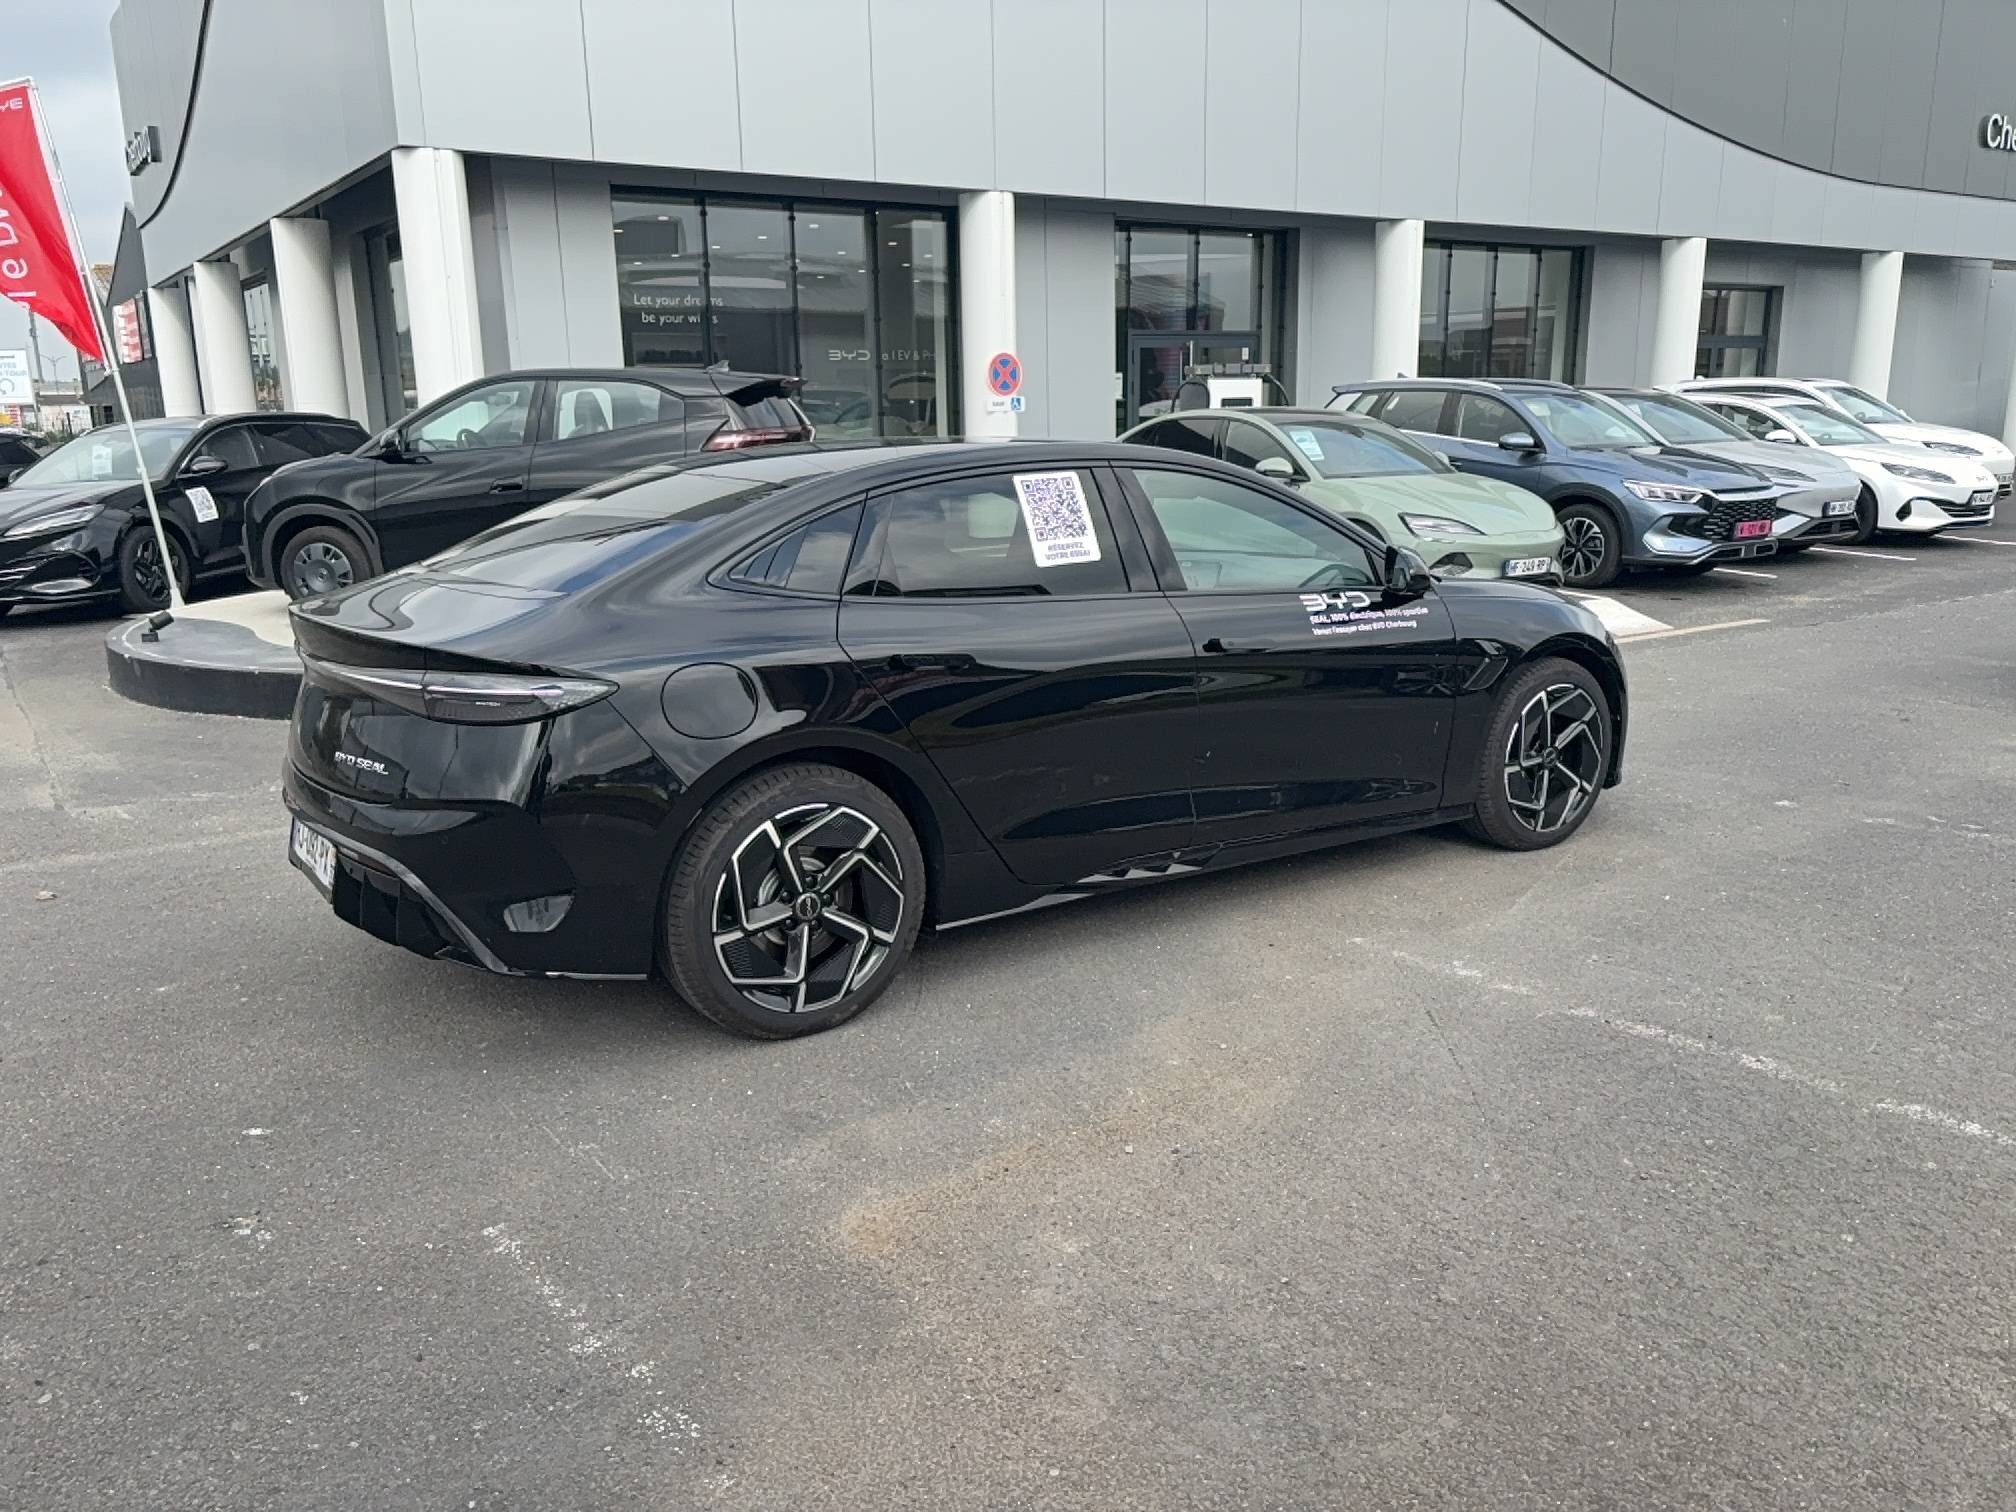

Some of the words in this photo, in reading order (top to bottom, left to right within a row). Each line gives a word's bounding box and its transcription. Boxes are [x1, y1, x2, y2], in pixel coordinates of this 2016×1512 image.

[633, 293, 653, 305] Let
[655, 297, 680, 309] your
[641, 311, 656, 323] be
[659, 315, 684, 326] your
[687, 315, 718, 324] wis
[828, 349, 871, 361] BYD
[1299, 591, 1371, 612] BYD
